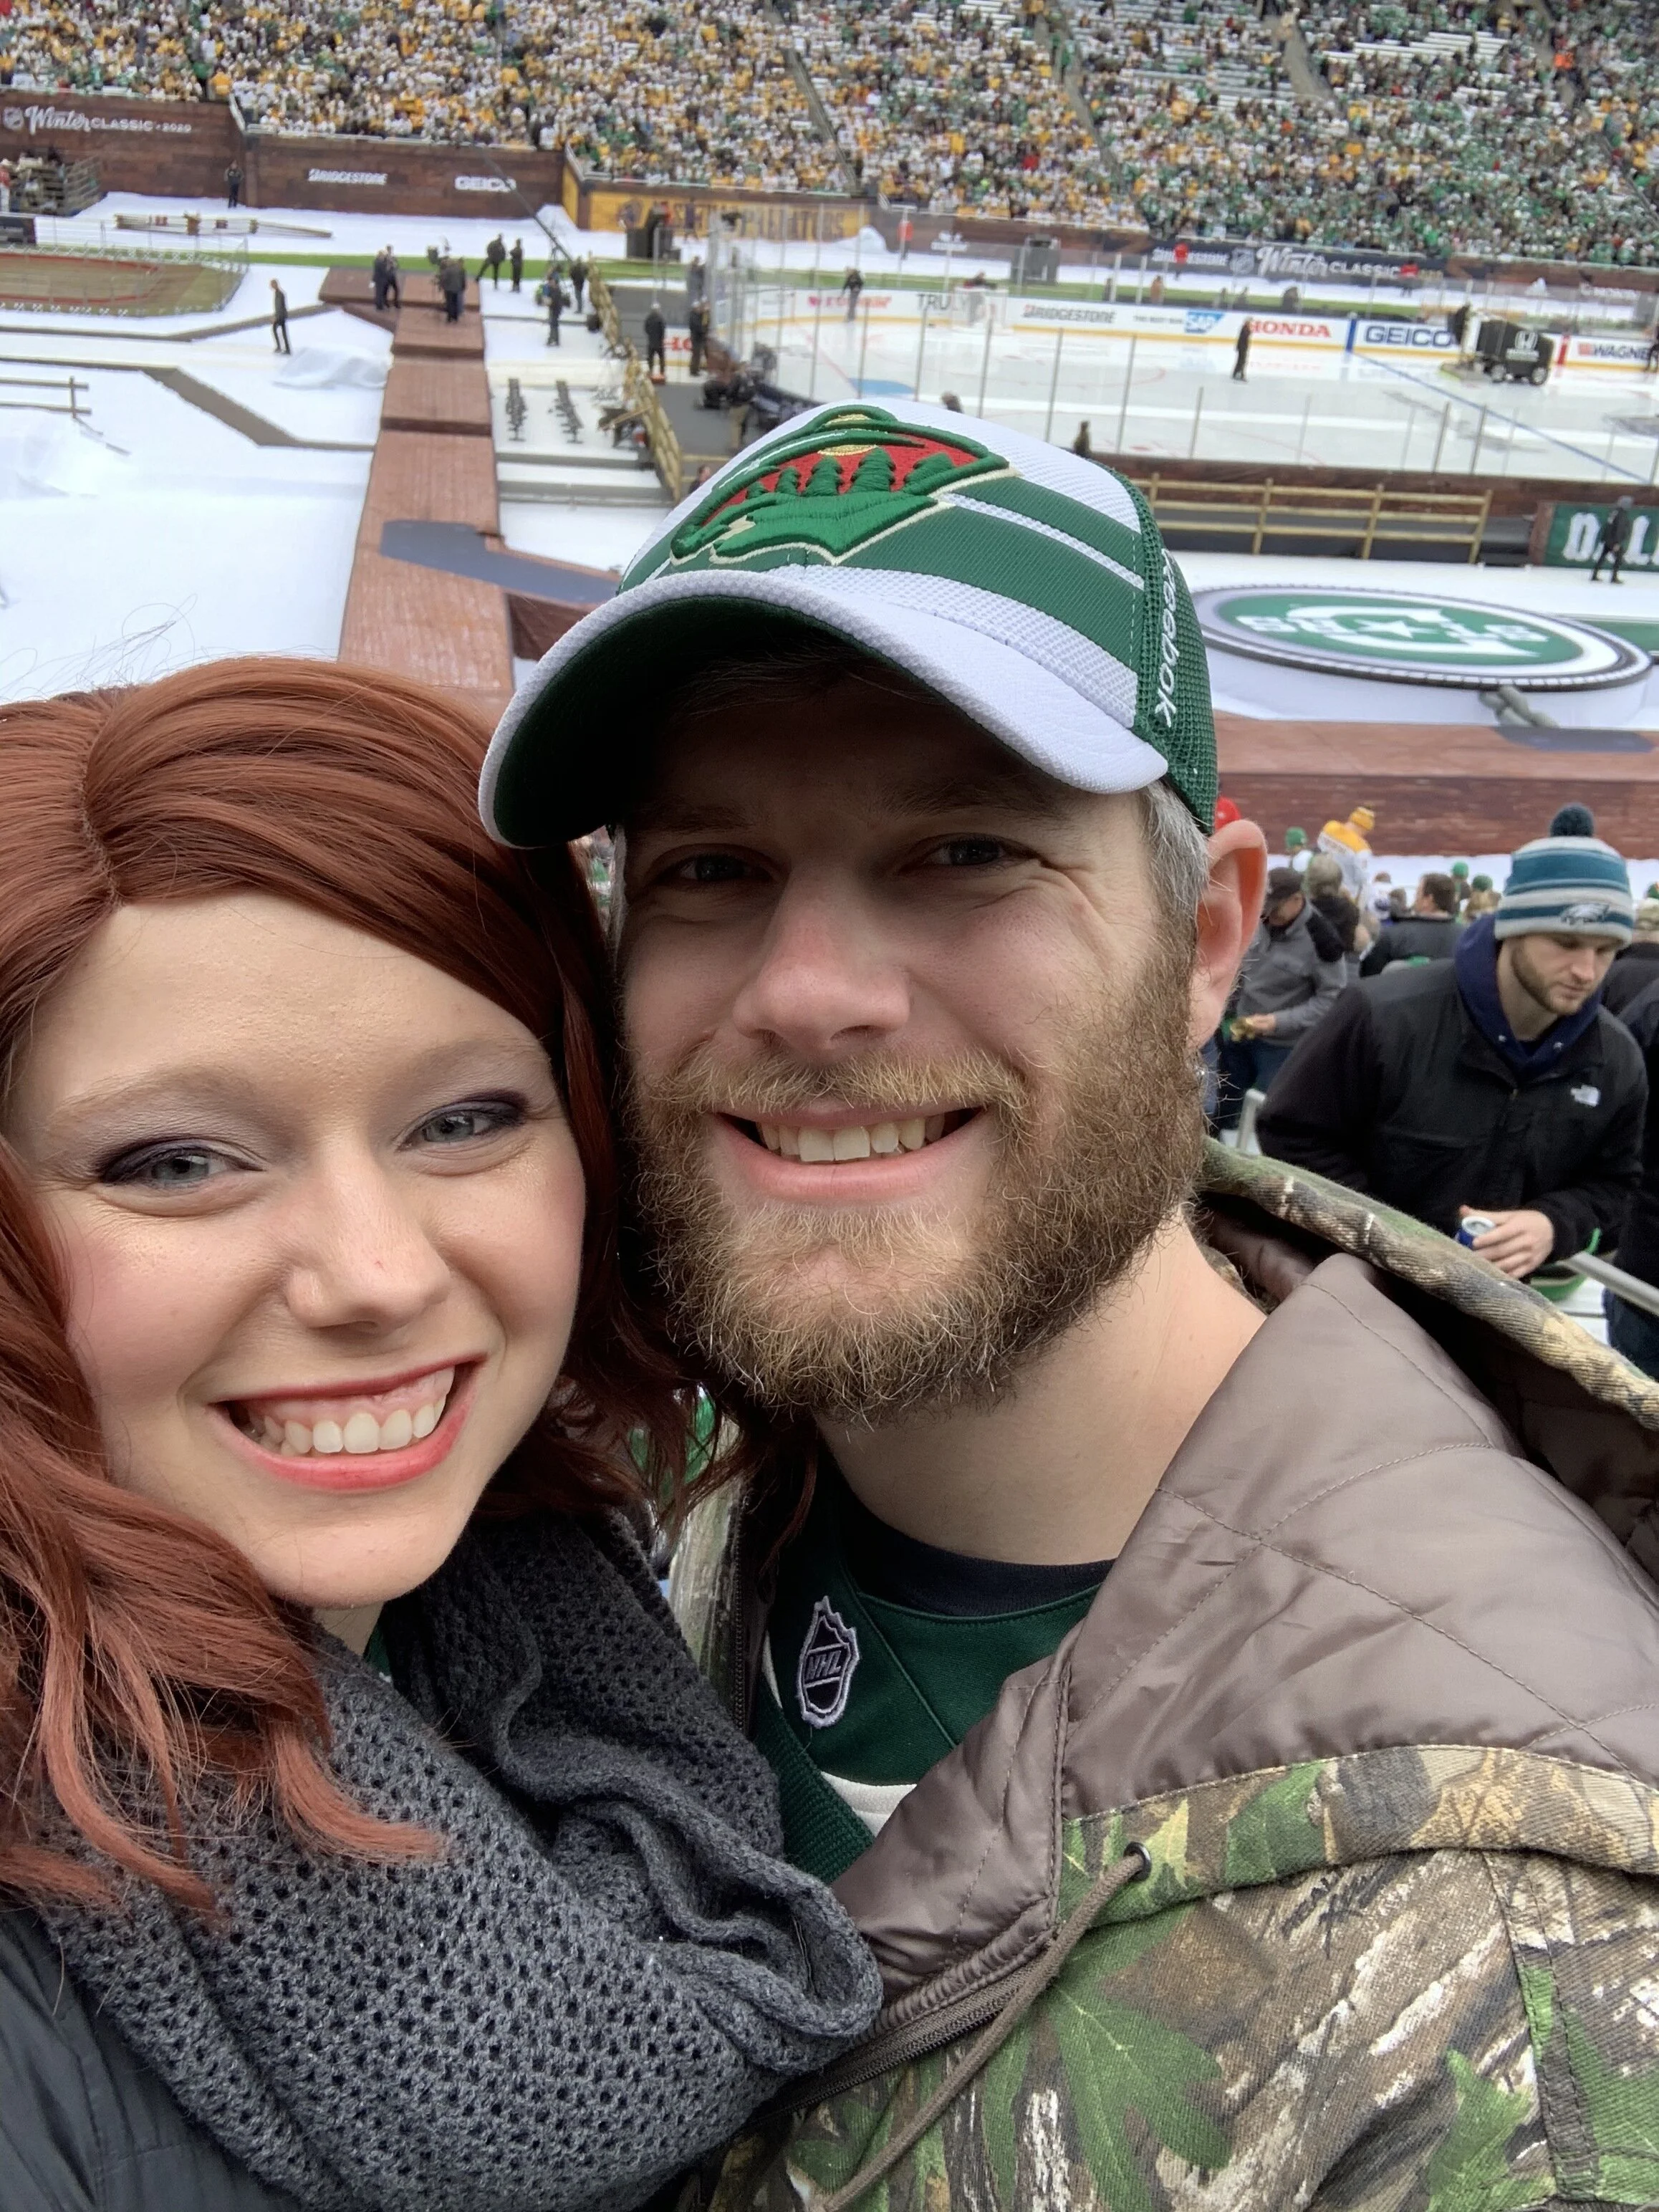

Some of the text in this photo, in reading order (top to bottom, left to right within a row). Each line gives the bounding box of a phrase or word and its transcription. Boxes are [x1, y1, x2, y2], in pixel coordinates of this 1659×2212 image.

[24, 105, 91, 135] Winter
[90, 117, 154, 132] CLASSIC
[1256, 246, 1328, 278] Winter
[1023, 304, 1117, 324] BRIDGESTONE
[1250, 320, 1332, 338] HONDA
[1365, 324, 1452, 347] GEICO
[1155, 548, 1180, 728] Reebok
[805, 1650, 842, 1681] NHL
